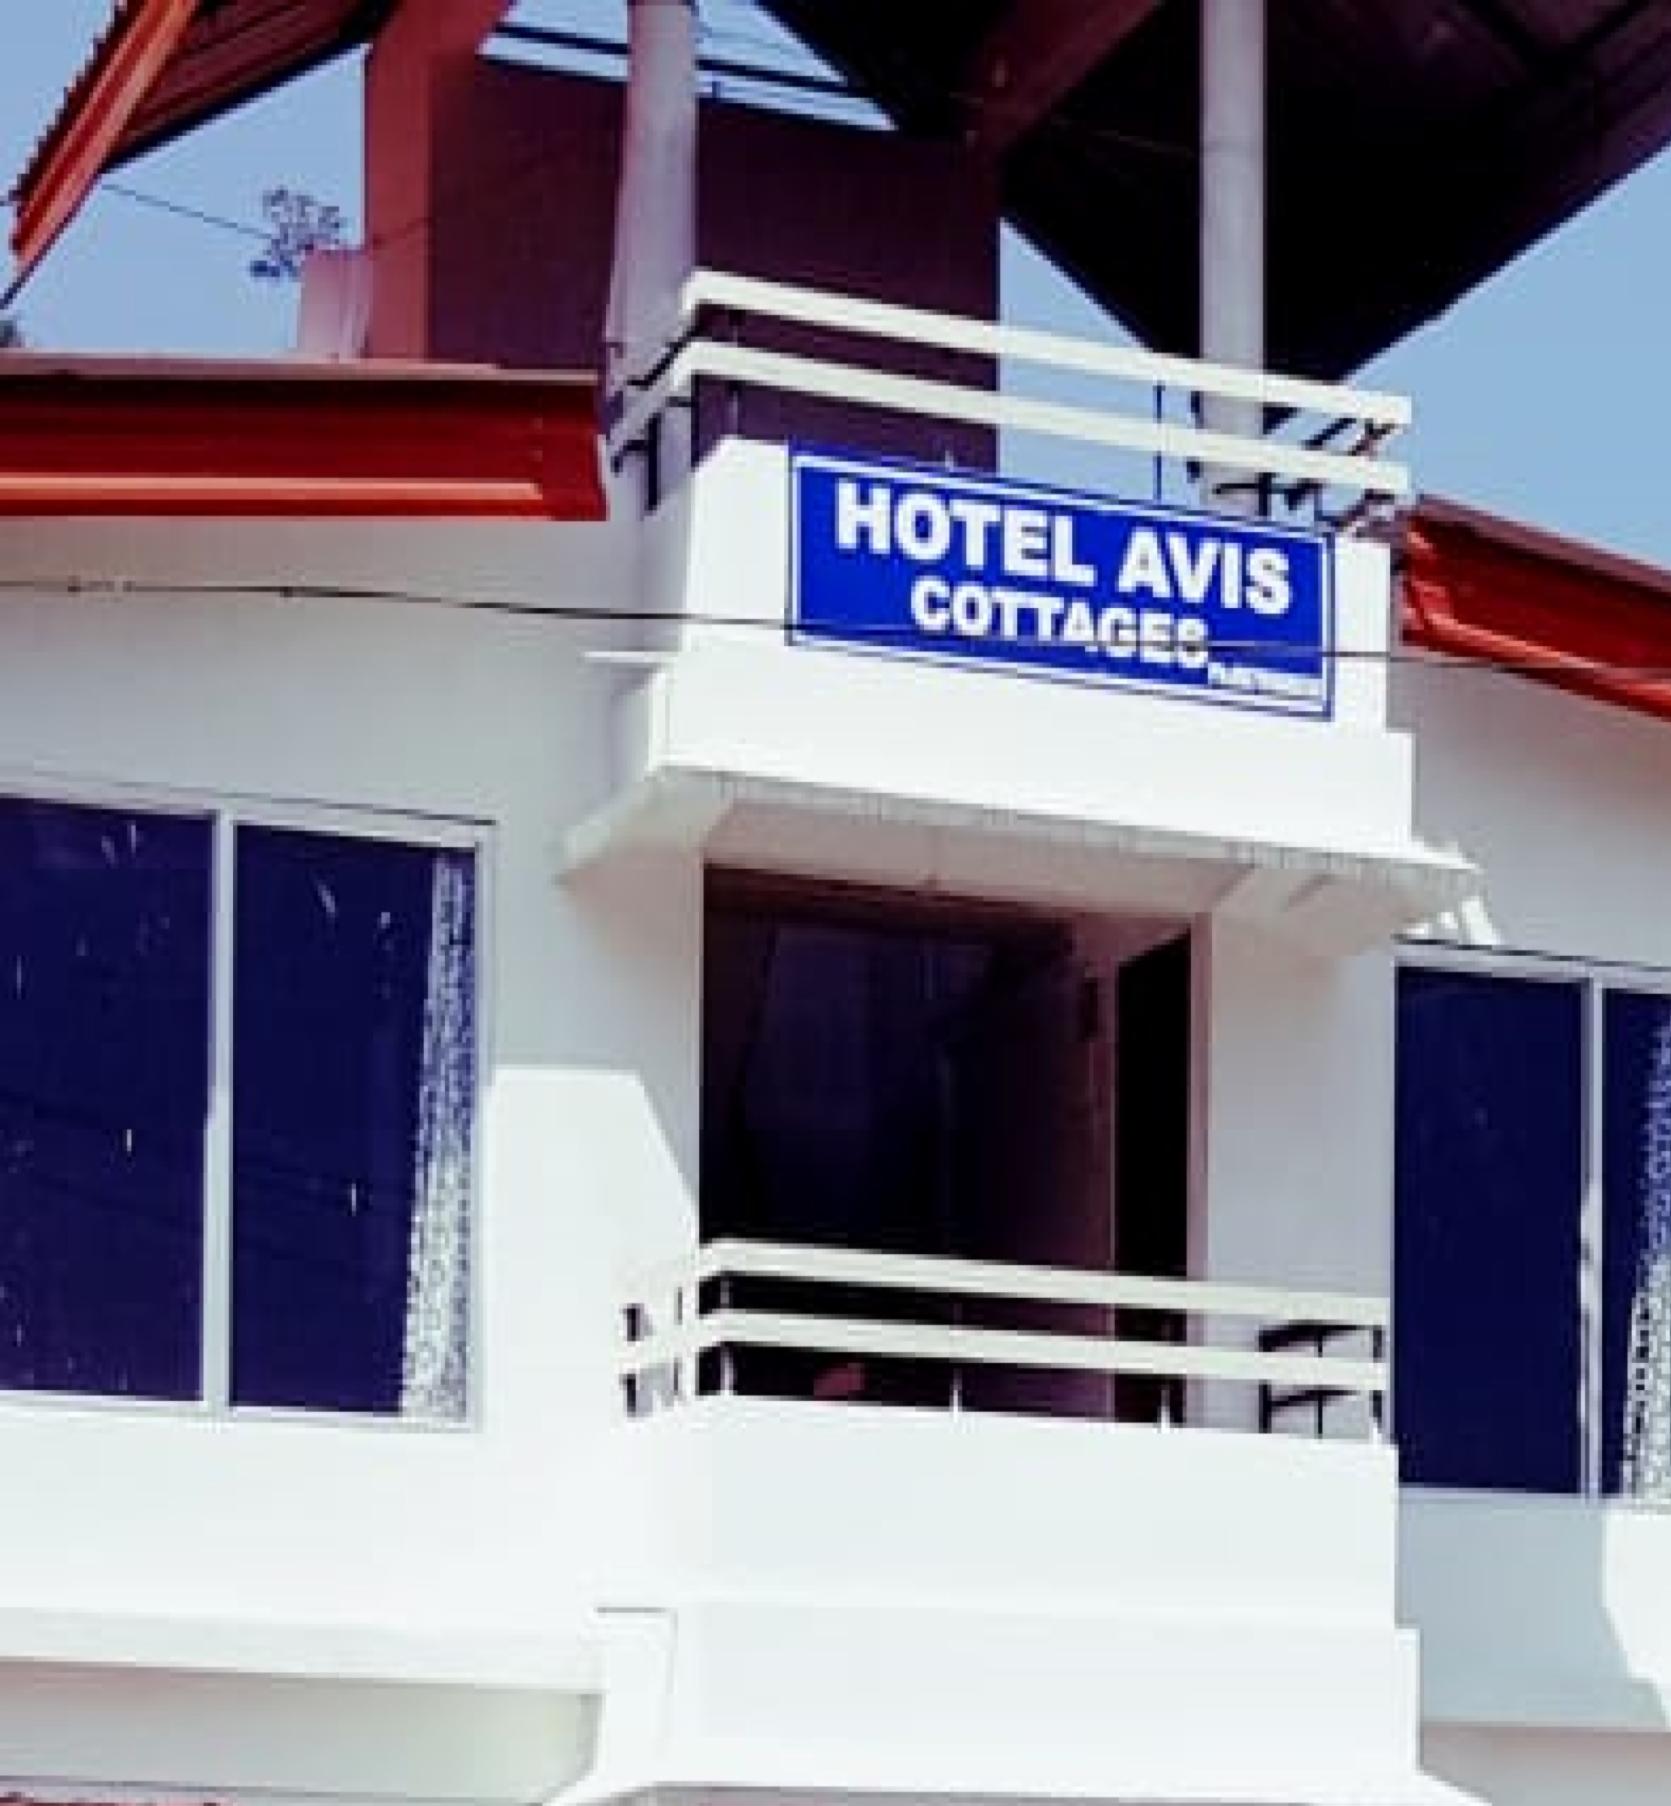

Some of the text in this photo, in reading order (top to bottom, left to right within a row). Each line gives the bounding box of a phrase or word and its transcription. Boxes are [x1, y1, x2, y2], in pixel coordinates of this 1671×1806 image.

[833, 479, 1292, 616] HOTEL AVIS
[910, 573, 1209, 669] COTTAGES
